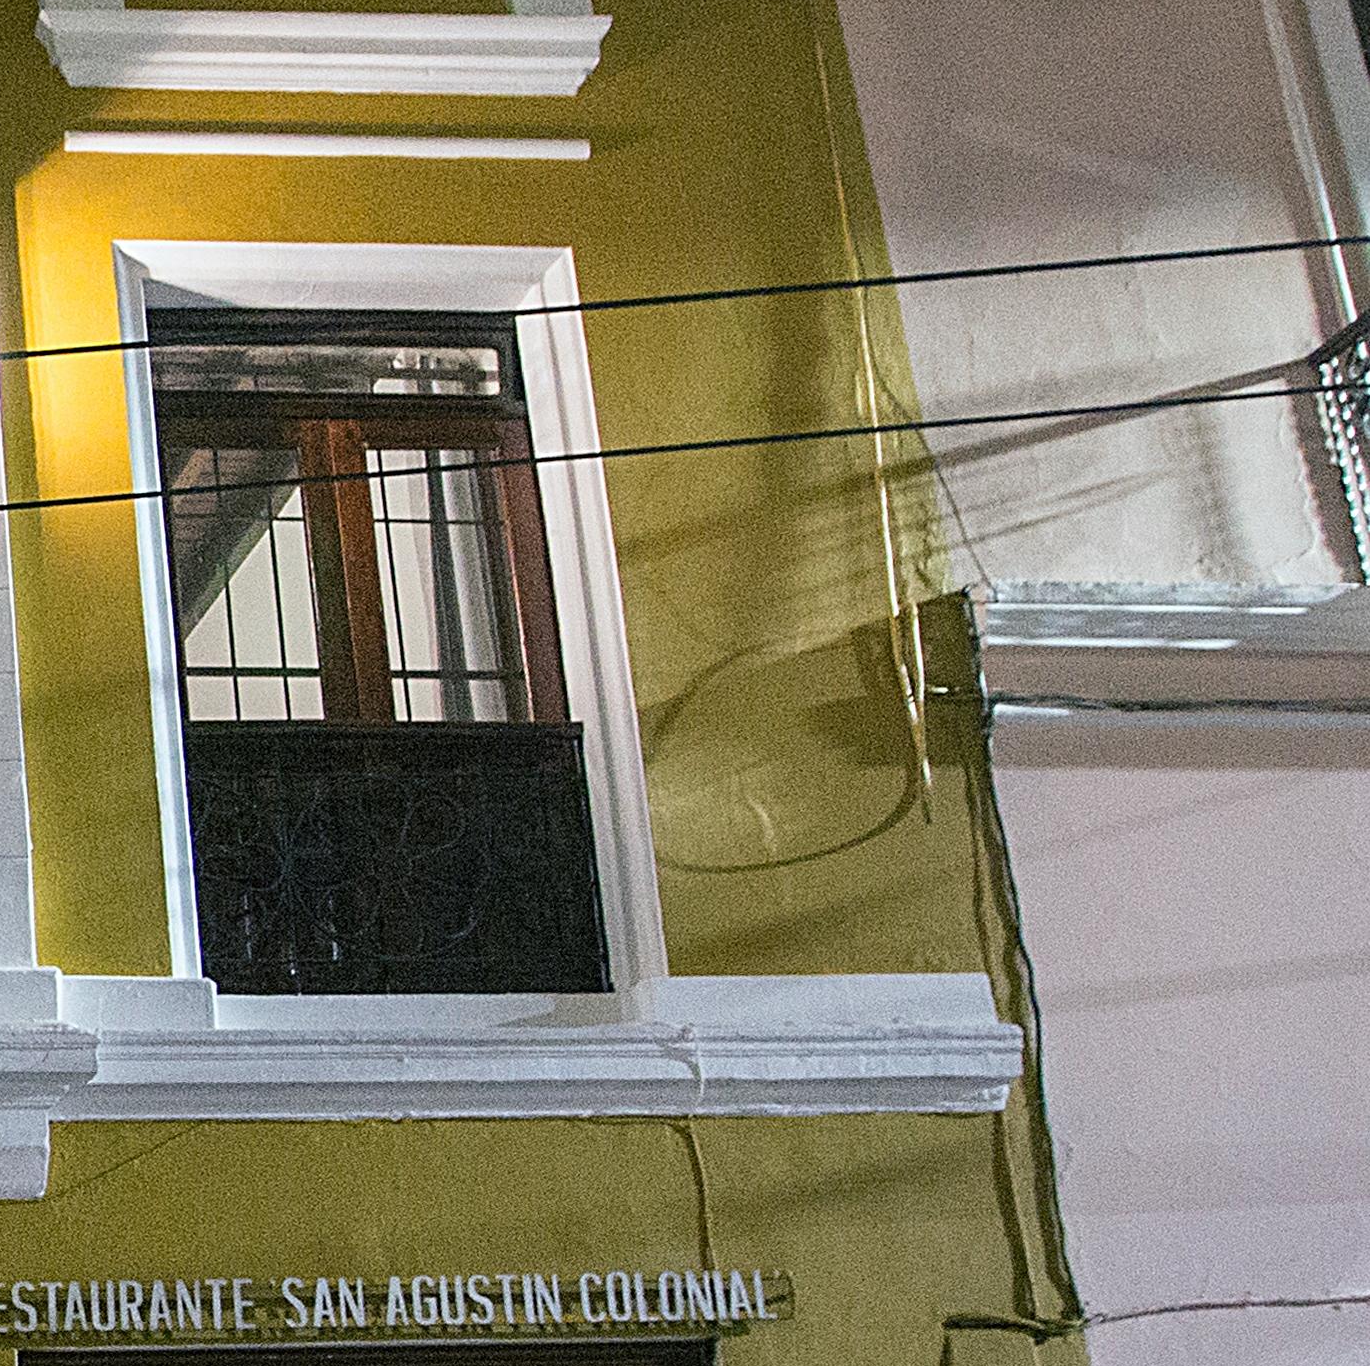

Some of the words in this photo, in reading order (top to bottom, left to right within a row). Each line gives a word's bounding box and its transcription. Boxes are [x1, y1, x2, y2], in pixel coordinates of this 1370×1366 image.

[281, 1277, 366, 1328] SAN
[386, 1272, 561, 1327] AGUSTIN
[579, 1268, 778, 1327] COLONIAL
